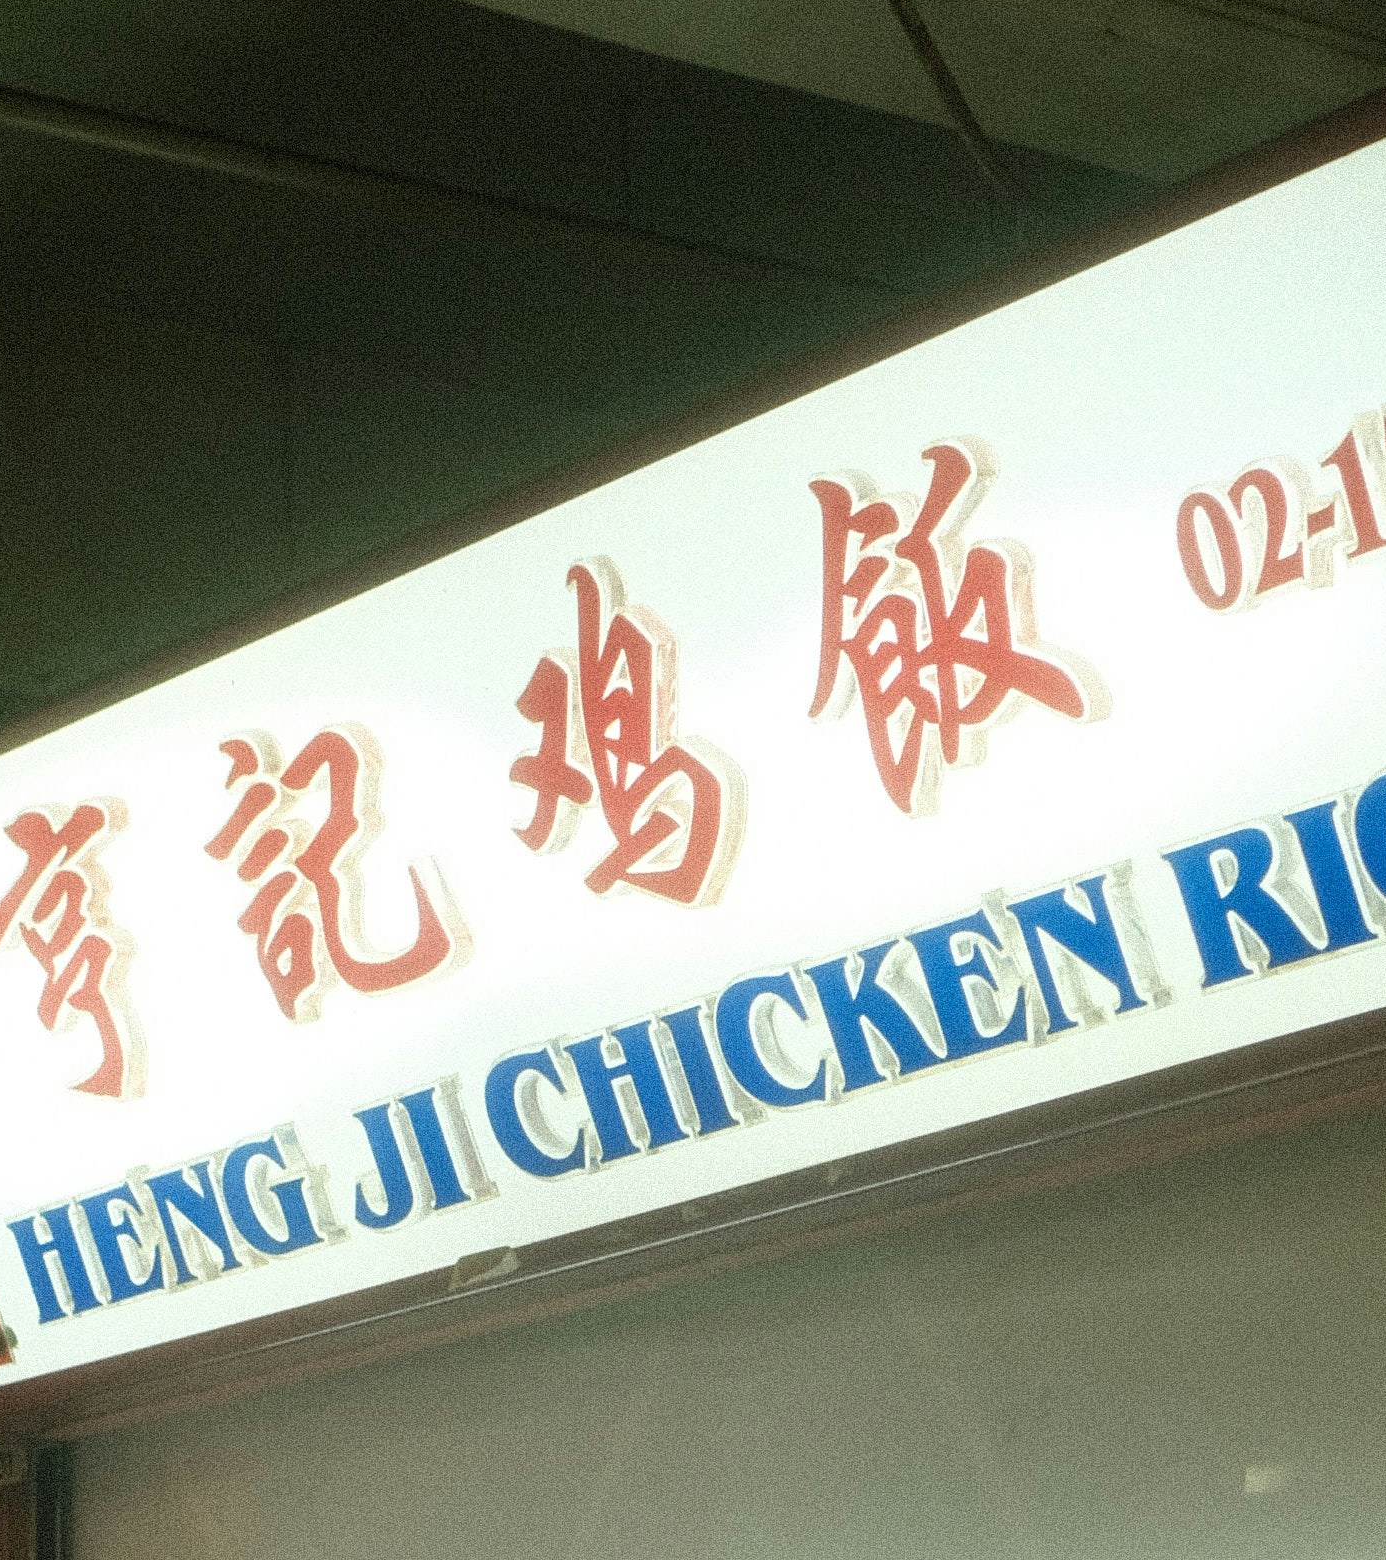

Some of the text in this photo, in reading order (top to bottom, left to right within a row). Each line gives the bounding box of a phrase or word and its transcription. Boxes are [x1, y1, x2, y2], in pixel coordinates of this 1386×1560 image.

[8, 1130, 338, 1326] HENG
[352, 1080, 493, 1231] JI
[485, 865, 1165, 1178] CHICKEN
